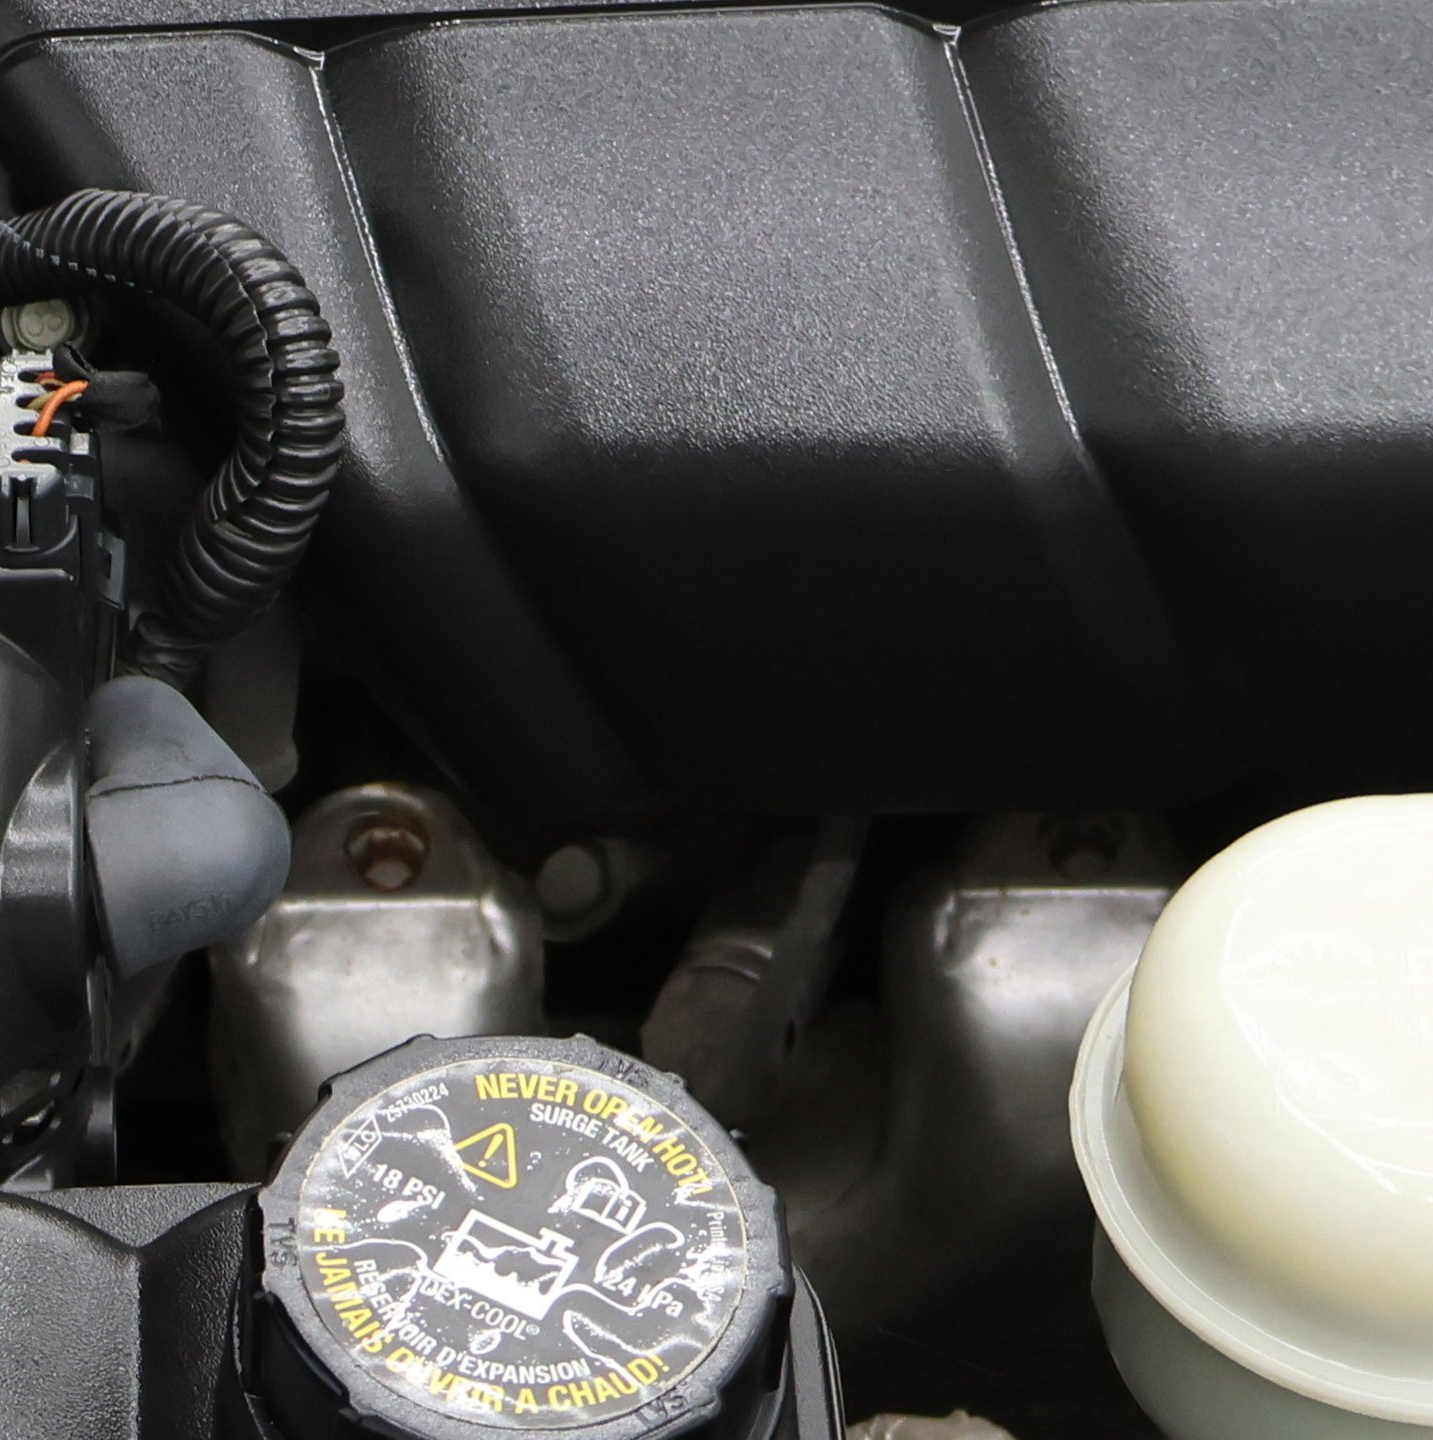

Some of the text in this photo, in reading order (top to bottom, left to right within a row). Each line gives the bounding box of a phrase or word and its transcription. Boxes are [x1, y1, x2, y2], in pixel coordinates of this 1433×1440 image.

[372, 1163, 446, 1210] 18 PSI
[475, 1072, 713, 1196] NEVER OPEN HOT!
[529, 1103, 655, 1173] SURGE TANK
[315, 1251, 394, 1353] JAMAIS
[514, 1388, 539, 1415] A
[547, 1355, 671, 1413] CHAUD!
[354, 1259, 592, 1386] RESERVOIR D'EXPANSION
